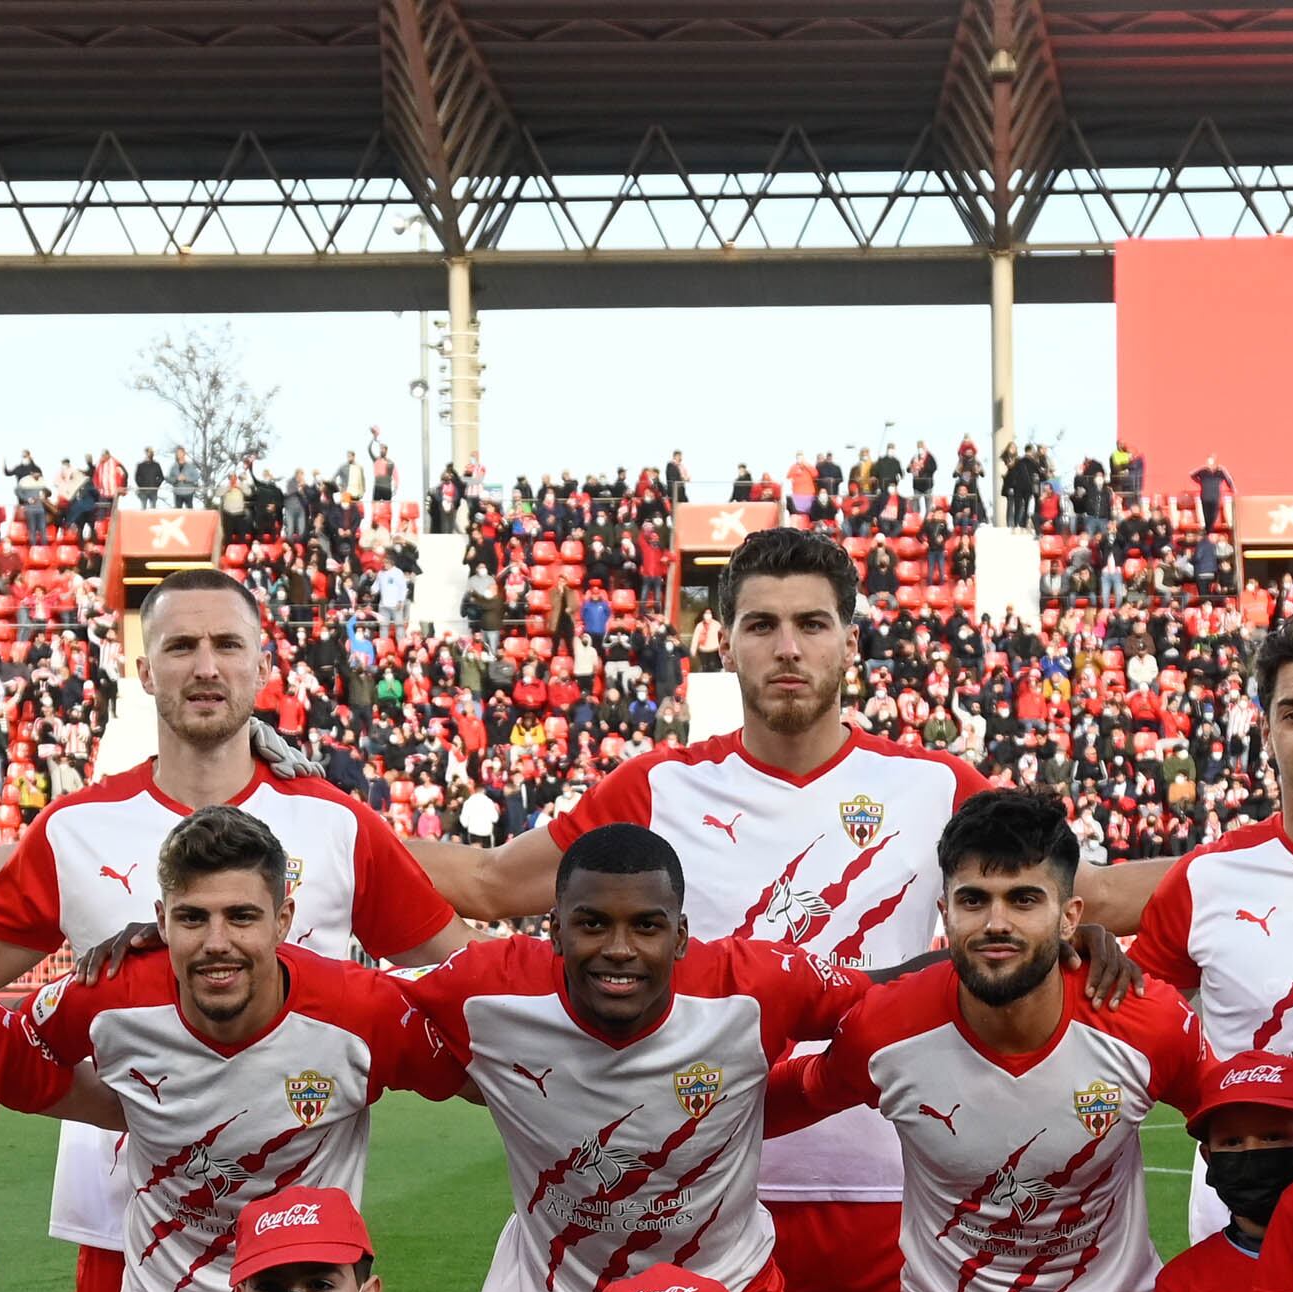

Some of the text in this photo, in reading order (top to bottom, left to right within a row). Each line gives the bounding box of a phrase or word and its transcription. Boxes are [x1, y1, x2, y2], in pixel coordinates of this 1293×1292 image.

[680, 1084, 716, 1095] ALMERIA
[291, 1091, 327, 1100] ALMERIA
[1080, 1103, 1116, 1113] ALMERIA
[255, 1204, 321, 1235] Coca-Cola
[547, 1201, 694, 1232] Arabian Centres
